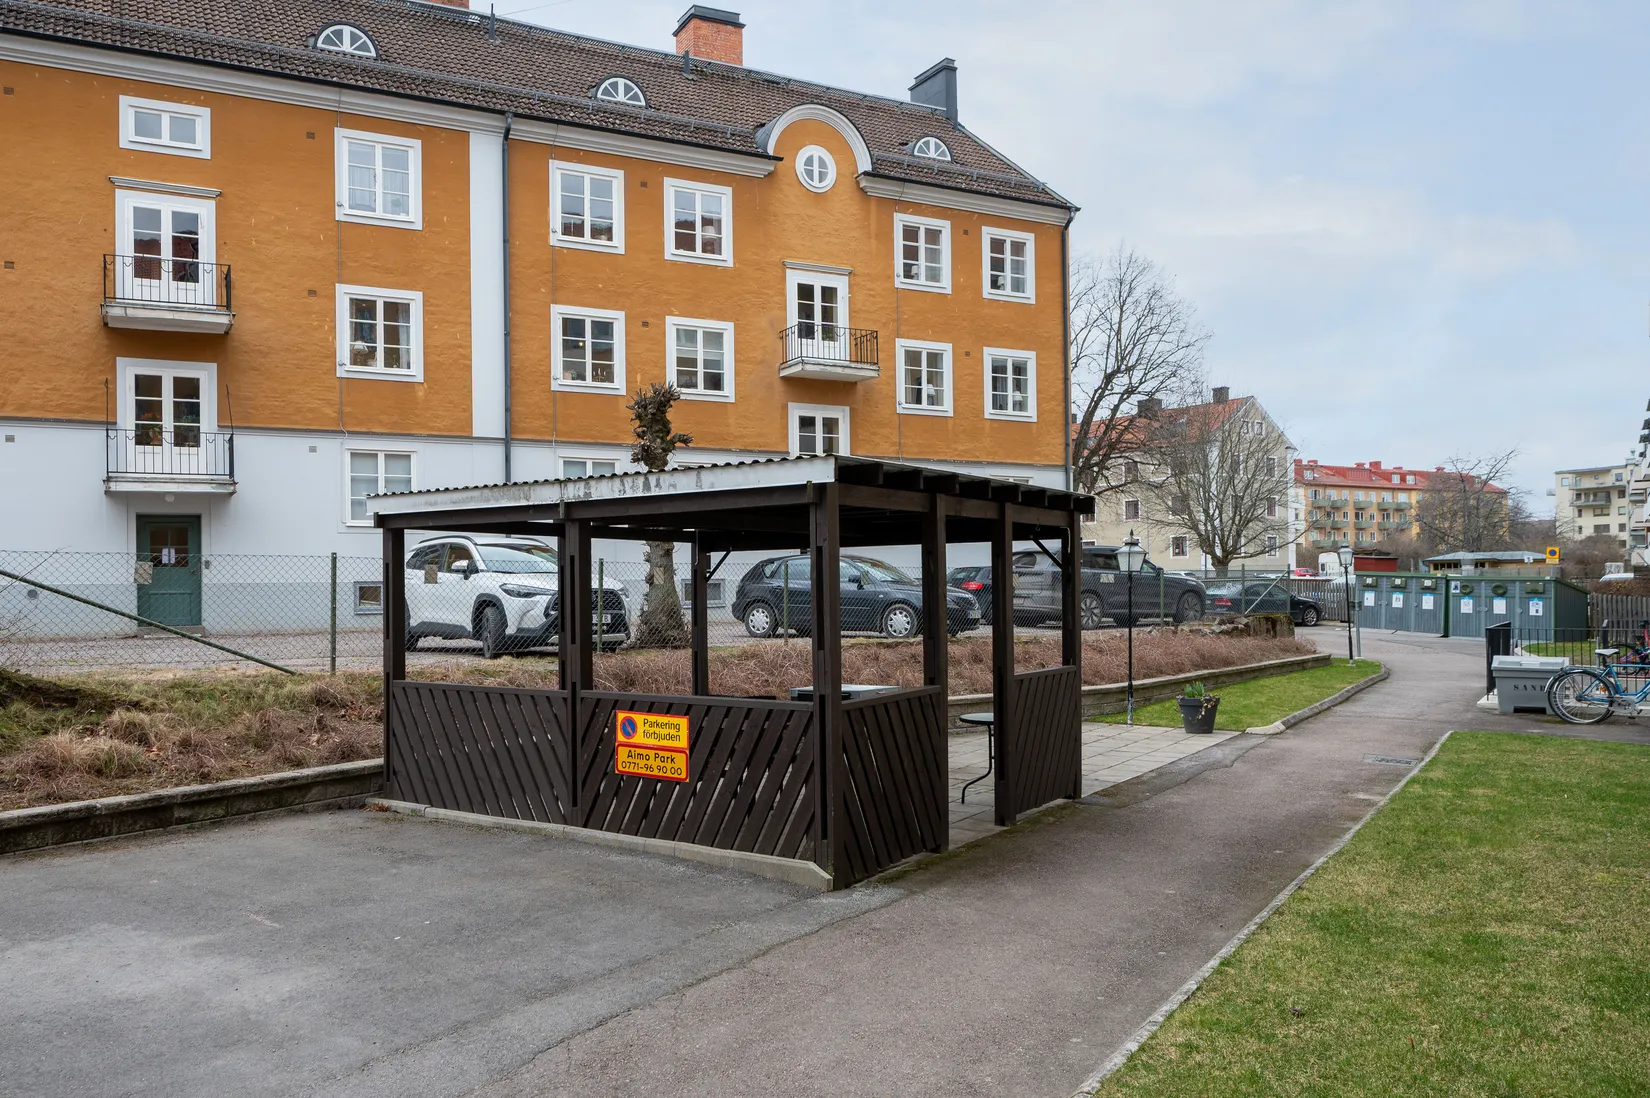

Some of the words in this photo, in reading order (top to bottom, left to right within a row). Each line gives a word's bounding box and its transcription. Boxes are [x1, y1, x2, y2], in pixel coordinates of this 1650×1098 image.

[643, 718, 680, 732] Parkering
[643, 730, 680, 742] förbjuden
[627, 750, 650, 761] Aimo
[654, 753, 676, 764] Park
[621, 761, 654, 773] 0771-96
[656, 765, 668, 774] 90
[670, 766, 682, 776] 00
